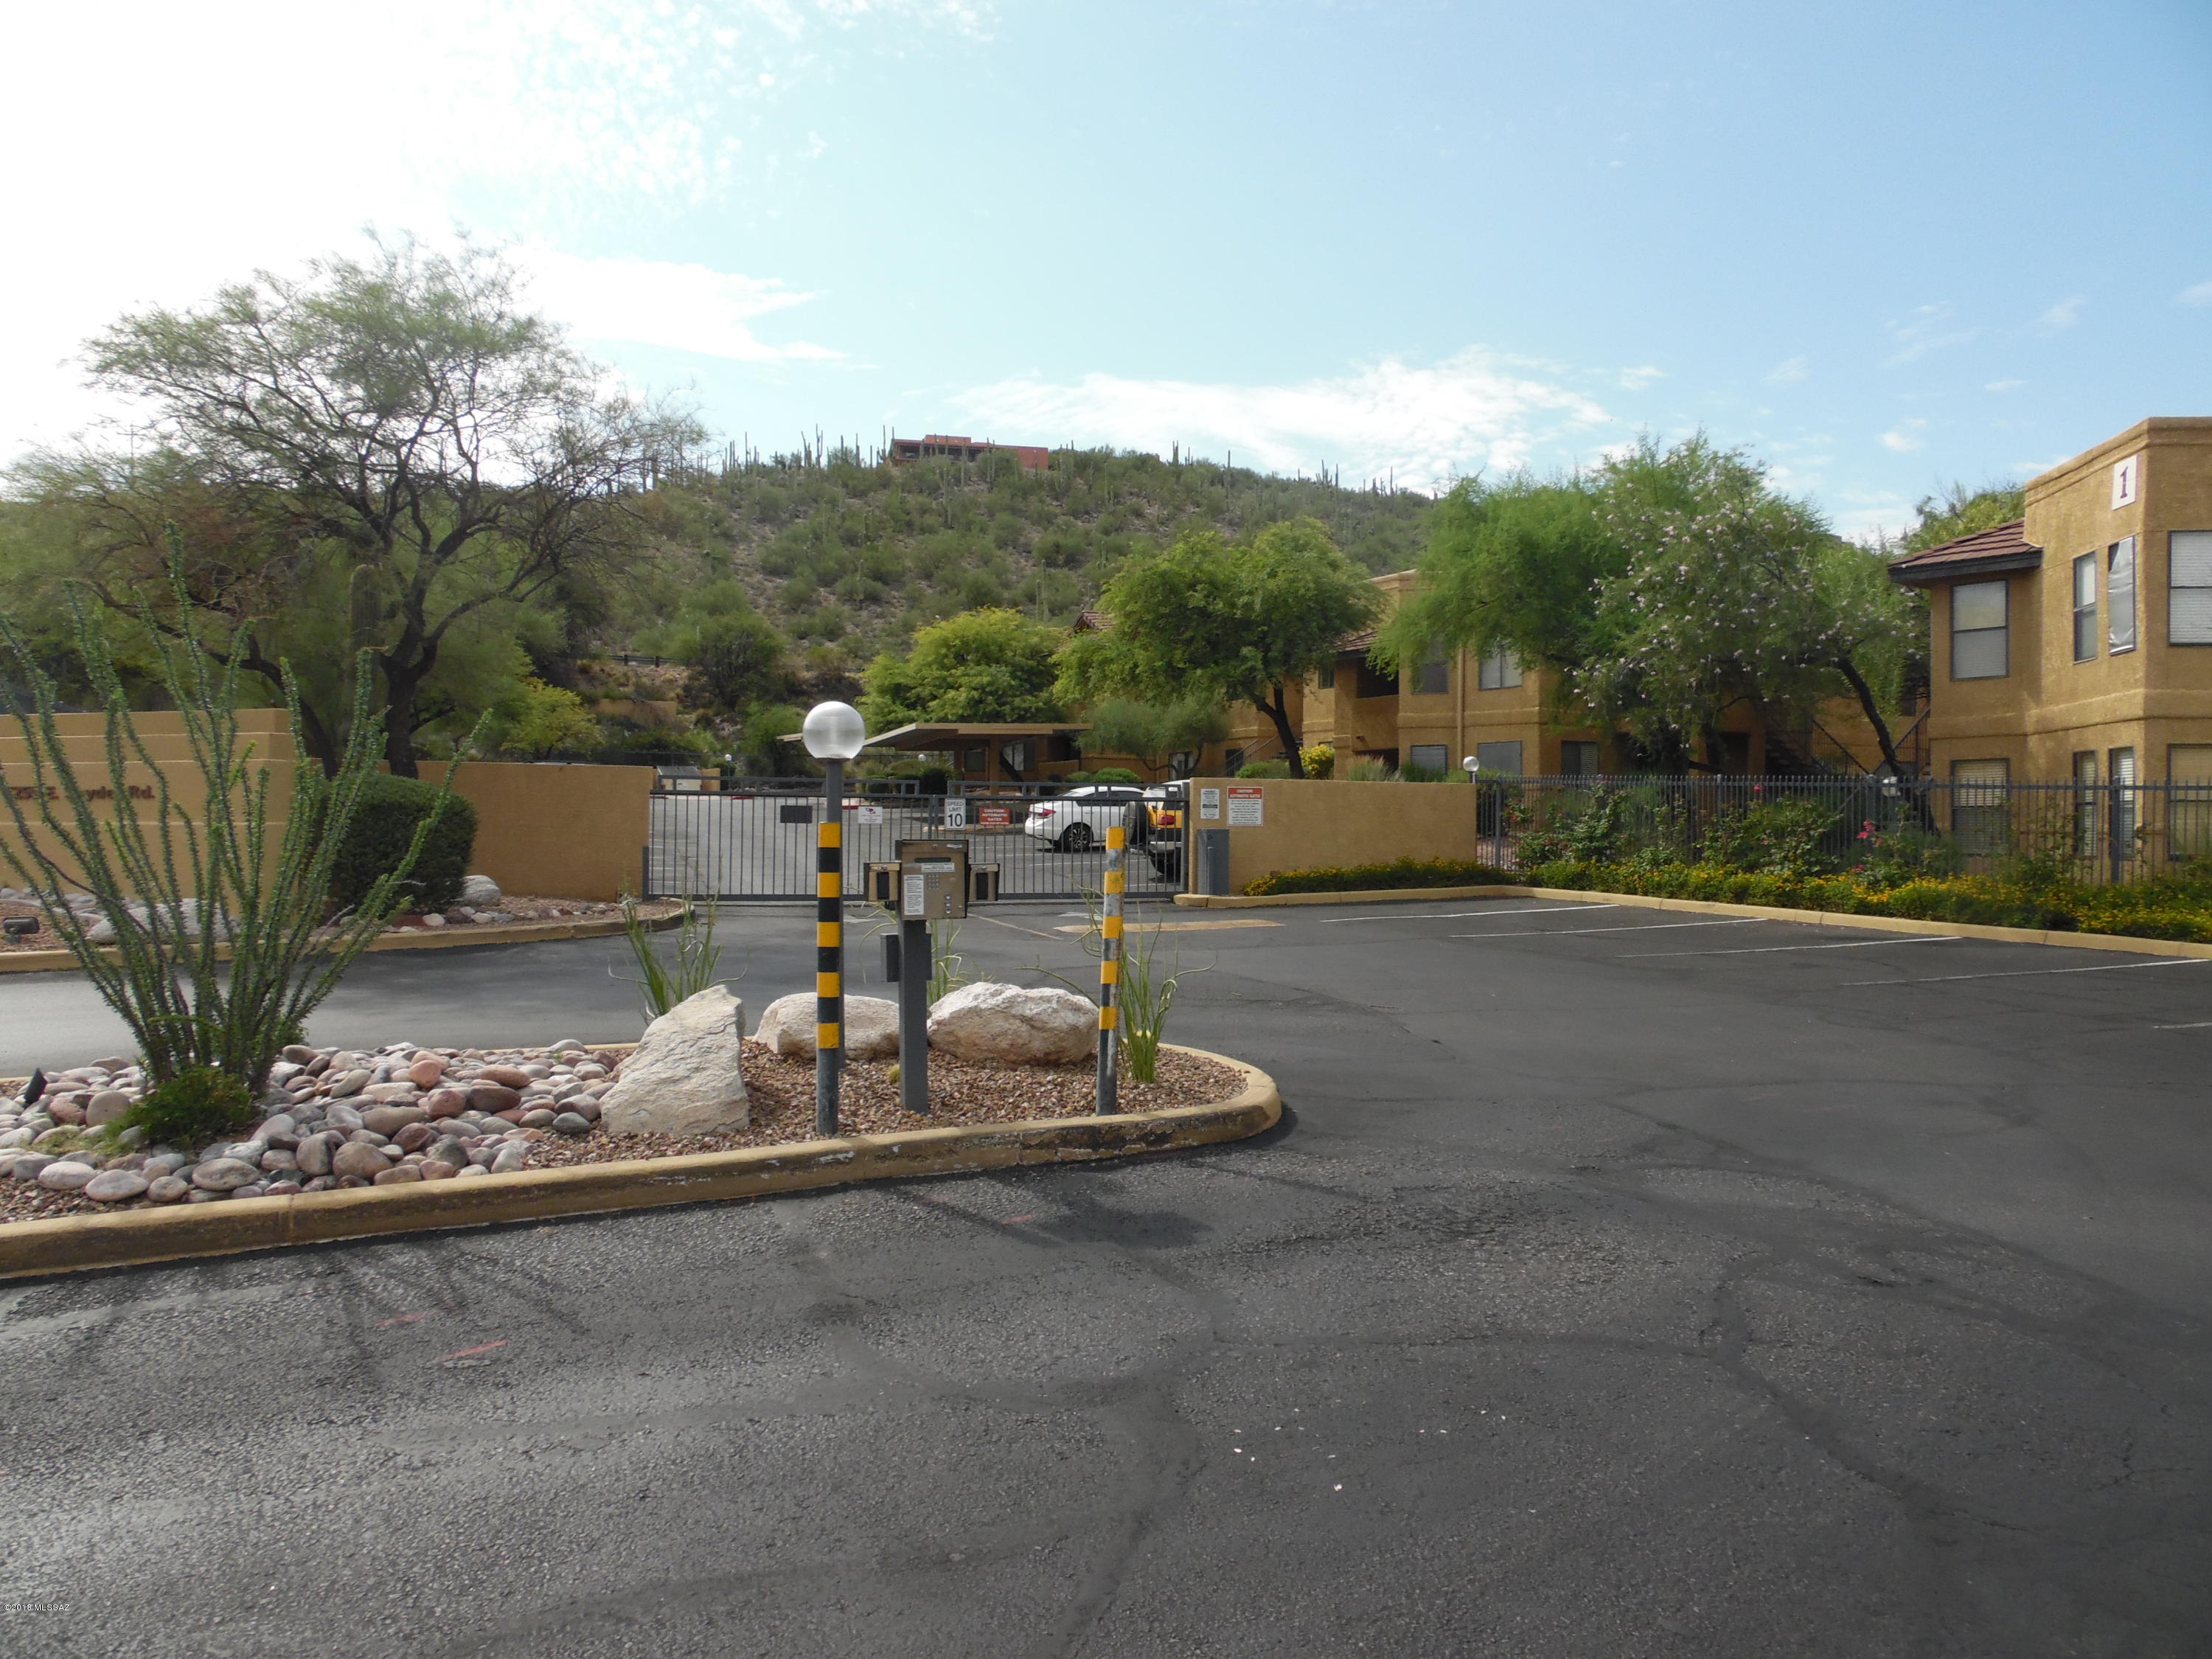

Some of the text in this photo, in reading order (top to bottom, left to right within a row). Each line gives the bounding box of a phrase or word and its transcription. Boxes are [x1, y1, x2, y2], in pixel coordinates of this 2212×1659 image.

[2121, 466, 2128, 498] 1
[128, 785, 156, 799] Rd.
[947, 813, 963, 827] 10
